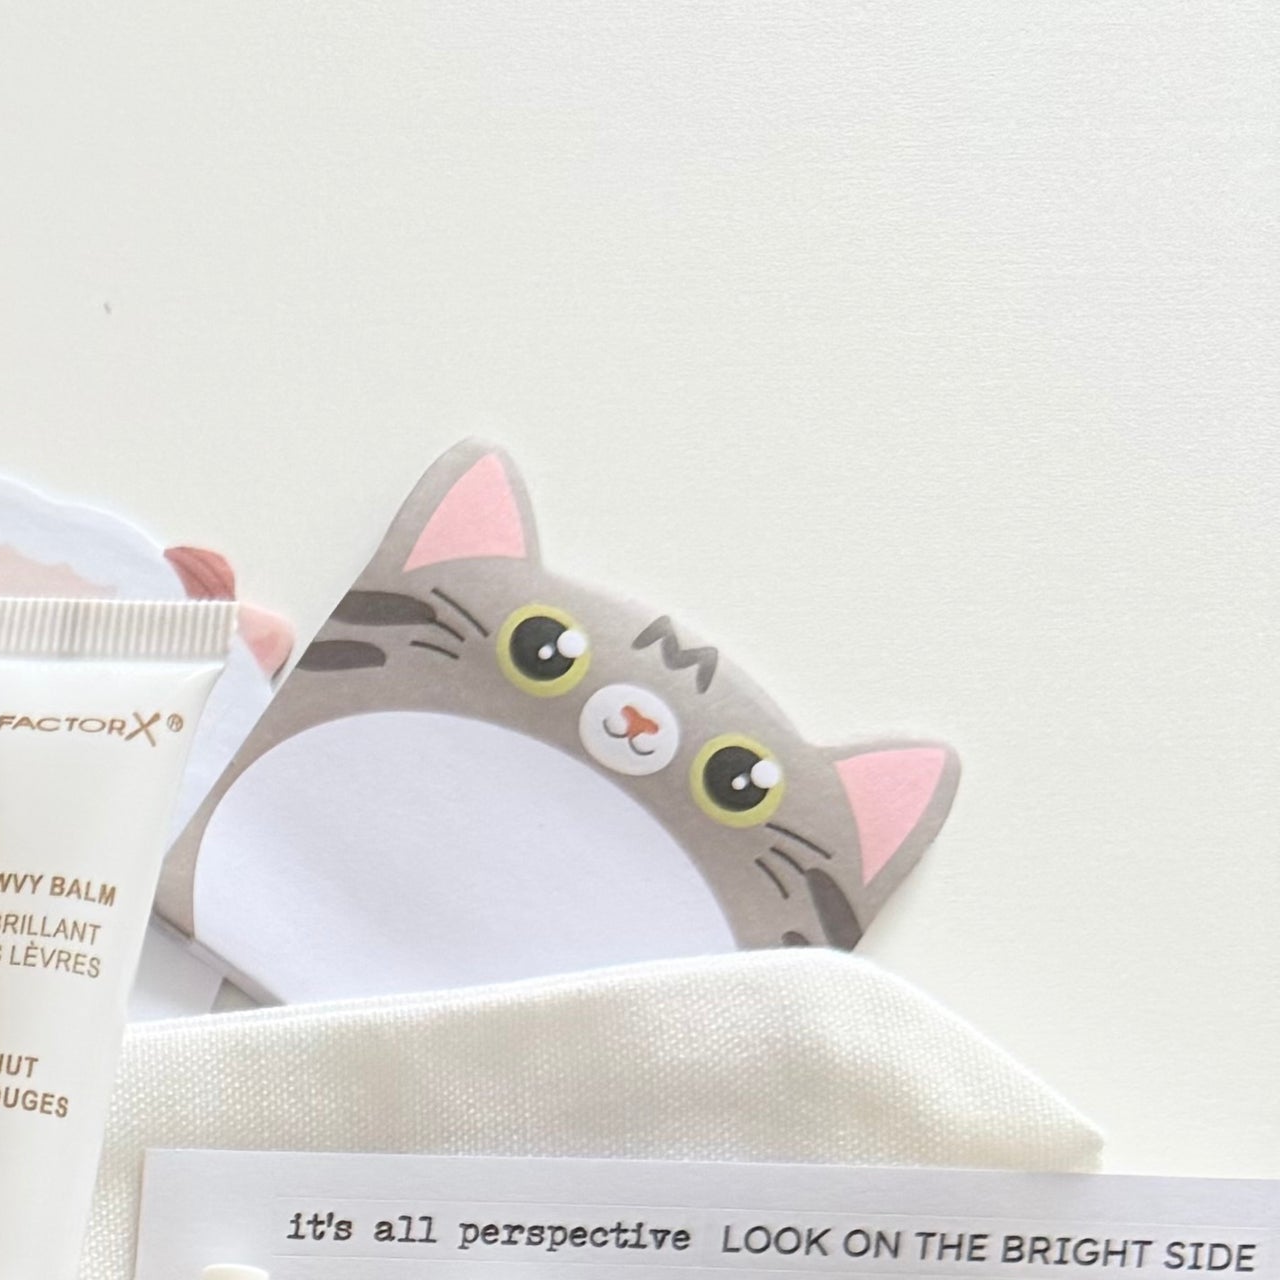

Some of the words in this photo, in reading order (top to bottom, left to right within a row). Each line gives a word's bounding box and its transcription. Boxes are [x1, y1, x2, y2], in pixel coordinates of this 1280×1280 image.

[49, 876, 117, 907] BALM
[9, 941, 102, 979] LÈVRES
[286, 1211, 354, 1242] it's
[373, 1215, 438, 1244] all
[457, 1219, 692, 1253] perspective
[721, 1223, 836, 1257] LOOK
[842, 1229, 901, 1259] ON
[915, 1231, 989, 1263] THE
[1000, 1235, 1153, 1269] BRIGHT
[1162, 1241, 1257, 1273] SIDE
